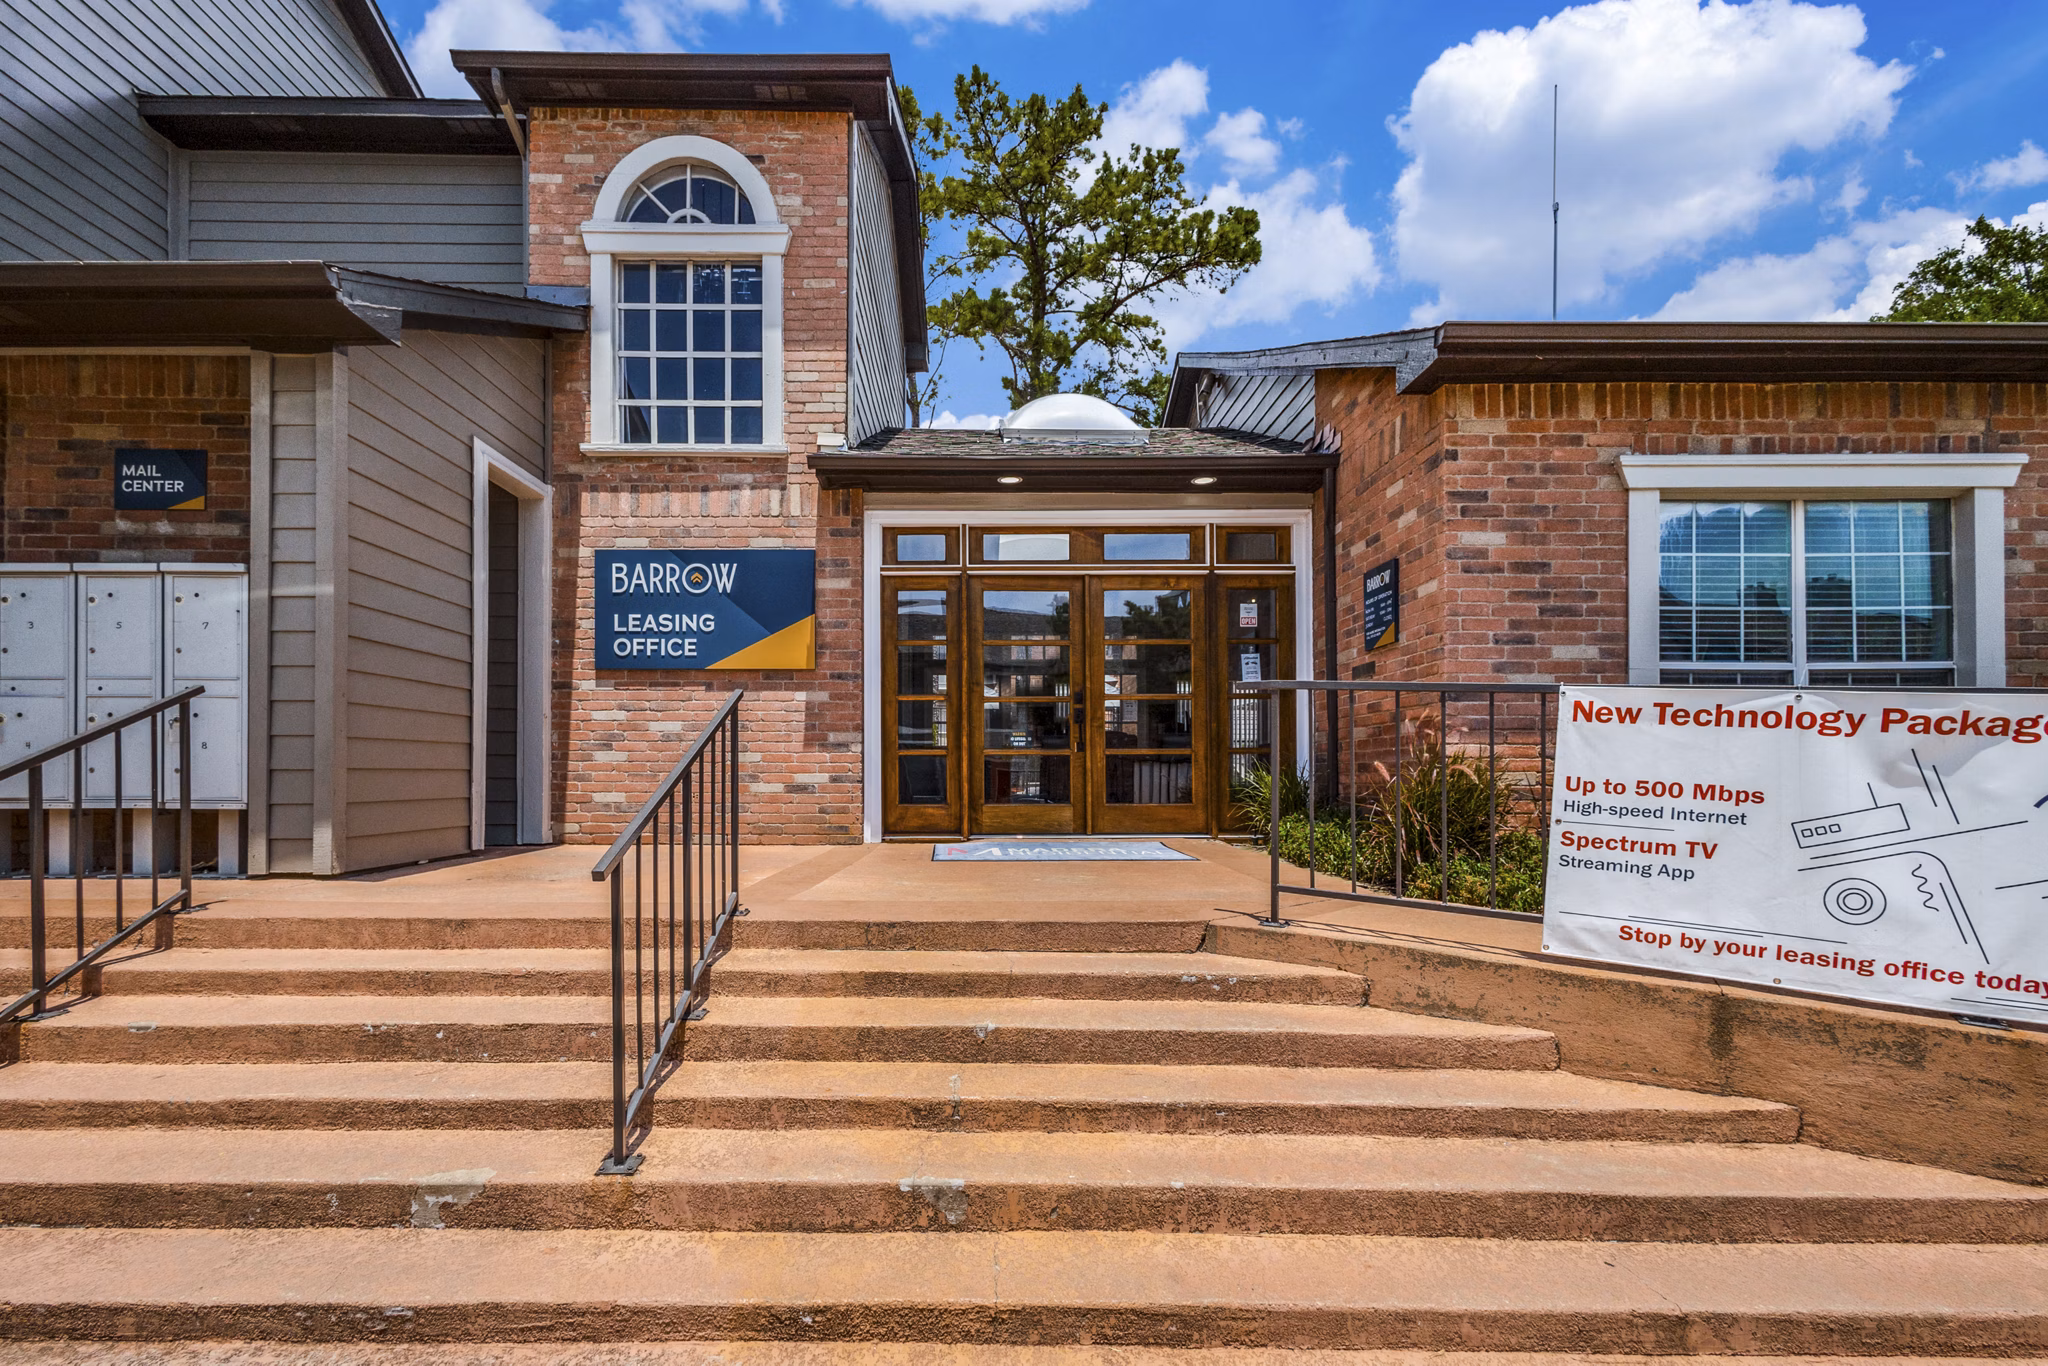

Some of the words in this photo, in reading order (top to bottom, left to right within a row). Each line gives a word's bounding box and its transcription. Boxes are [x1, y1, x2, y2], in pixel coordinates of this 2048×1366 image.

[122, 464, 162, 476] MAIL
[122, 480, 184, 492] CENTER
[611, 562, 738, 594] BARROW
[1366, 569, 1391, 592] BARROW
[27, 621, 35, 630] 3
[115, 621, 123, 630] 5
[202, 621, 210, 630] 7
[613, 614, 715, 632] LEASING
[1241, 617, 1256, 625] OPEN
[613, 638, 698, 656] OFFICE
[1574, 700, 1642, 724] New
[1654, 702, 1866, 736] Technology
[1882, 708, 2048, 742] Packag
[25, 741, 31, 750] 4
[201, 741, 208, 750] 8
[1566, 776, 1594, 796] Up
[1604, 780, 1626, 794] to
[1636, 780, 1684, 798] 500
[1694, 784, 1764, 806] Mbps
[1564, 800, 1663, 818] High-speed
[1671, 807, 1747, 825] Internet
[1562, 832, 1676, 856] Spectrum
[1686, 842, 1718, 858] TV
[1559, 855, 1652, 878] Streaming
[1658, 864, 1694, 881] App
[1620, 926, 1672, 948] Stop
[1680, 932, 1706, 952] by
[1714, 940, 1766, 958] your
[1776, 946, 1874, 976] leasing
[1884, 960, 1964, 984] office
